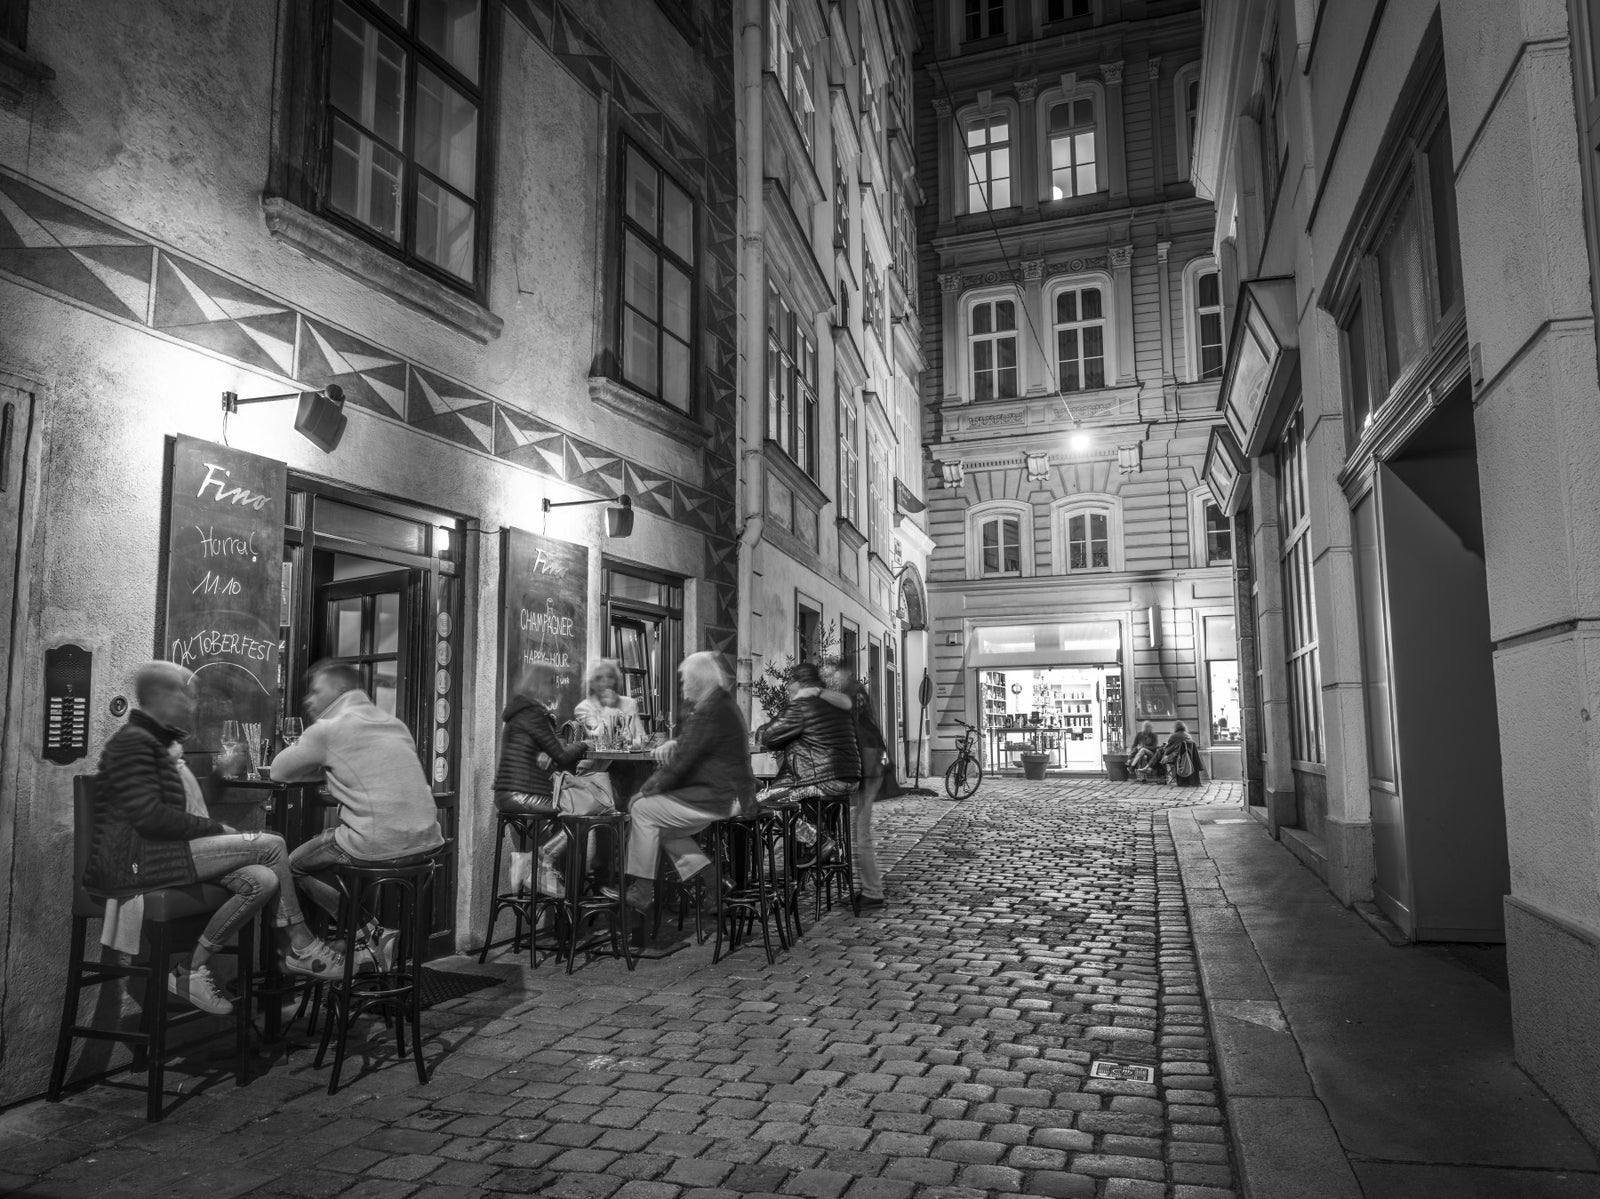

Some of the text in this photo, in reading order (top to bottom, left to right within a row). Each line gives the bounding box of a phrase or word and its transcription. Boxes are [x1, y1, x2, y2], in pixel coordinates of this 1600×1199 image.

[196, 462, 272, 511] Fino
[520, 608, 575, 638] CHAMPAGNER
[172, 630, 276, 670] OKTOBERFEST
